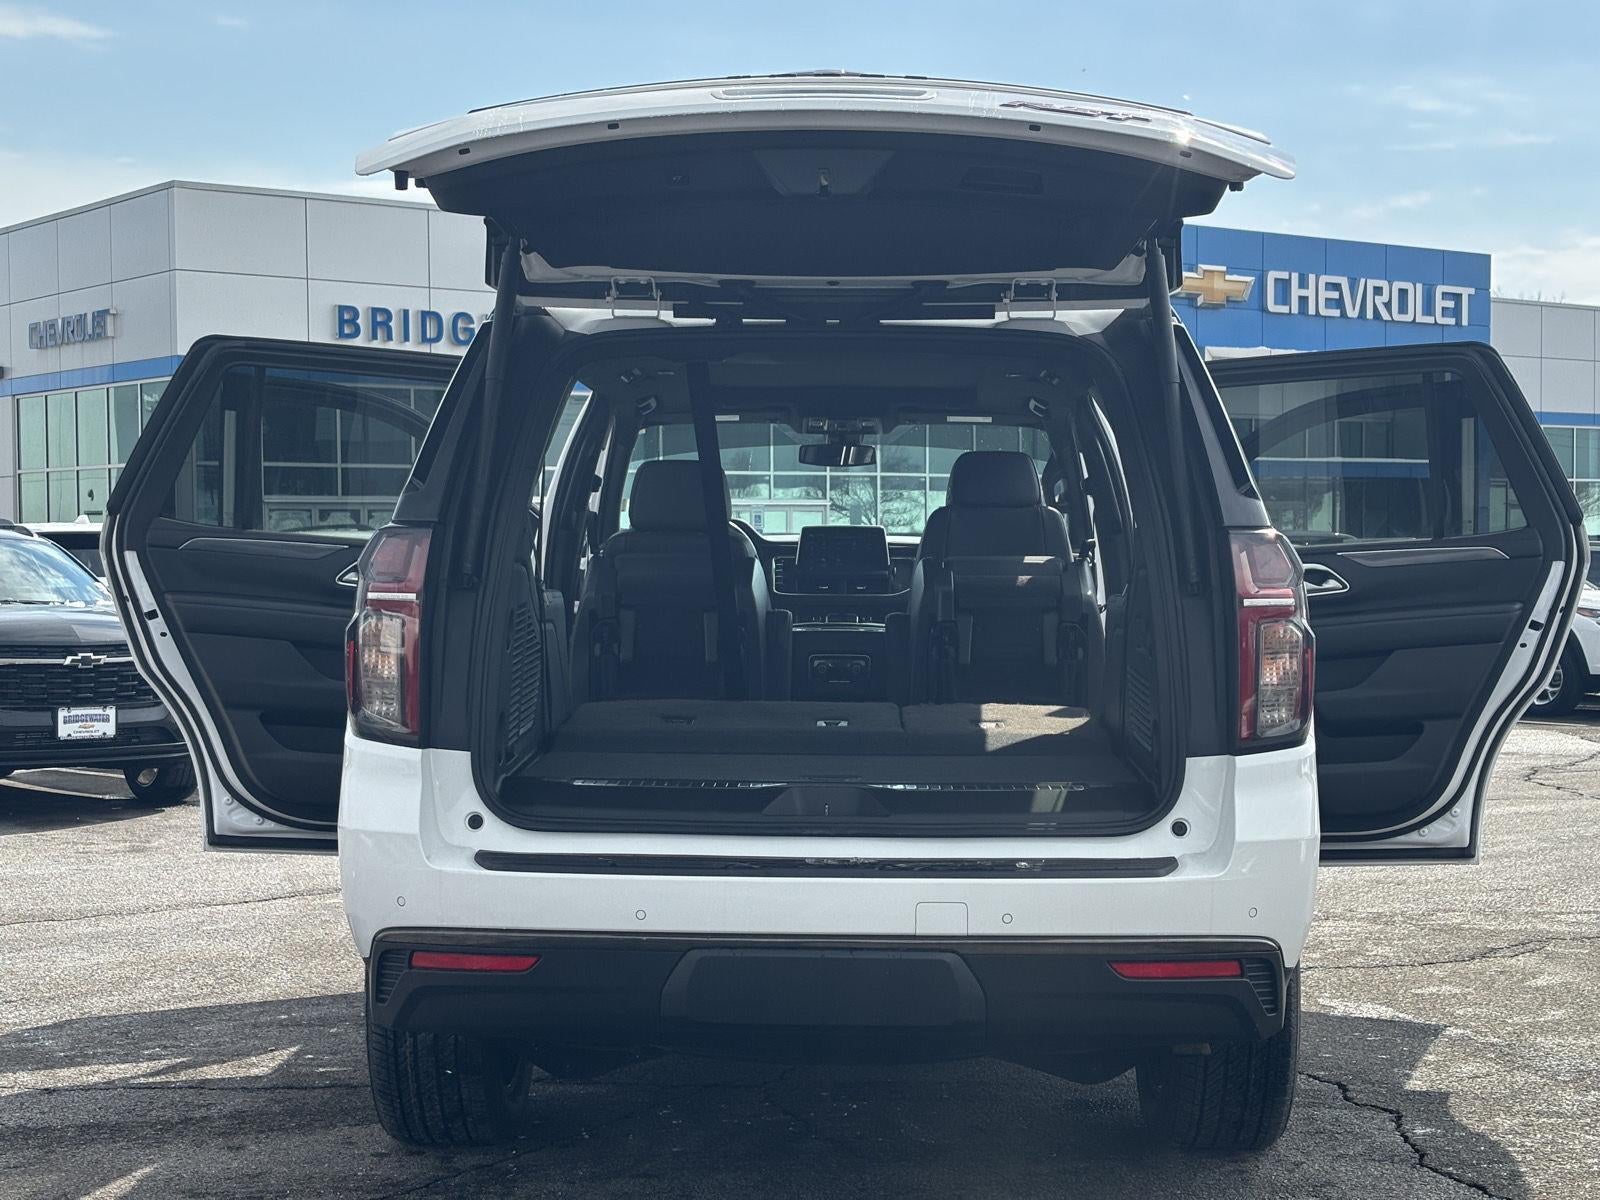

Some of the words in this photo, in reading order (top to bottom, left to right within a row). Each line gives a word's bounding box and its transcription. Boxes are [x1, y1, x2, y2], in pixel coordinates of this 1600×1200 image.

[1266, 270, 1476, 327] CHEVROLET
[28, 308, 116, 350] CHEVROLET
[335, 304, 487, 347] BRIDG
[63, 713, 110, 724] BRIDGEWATER
